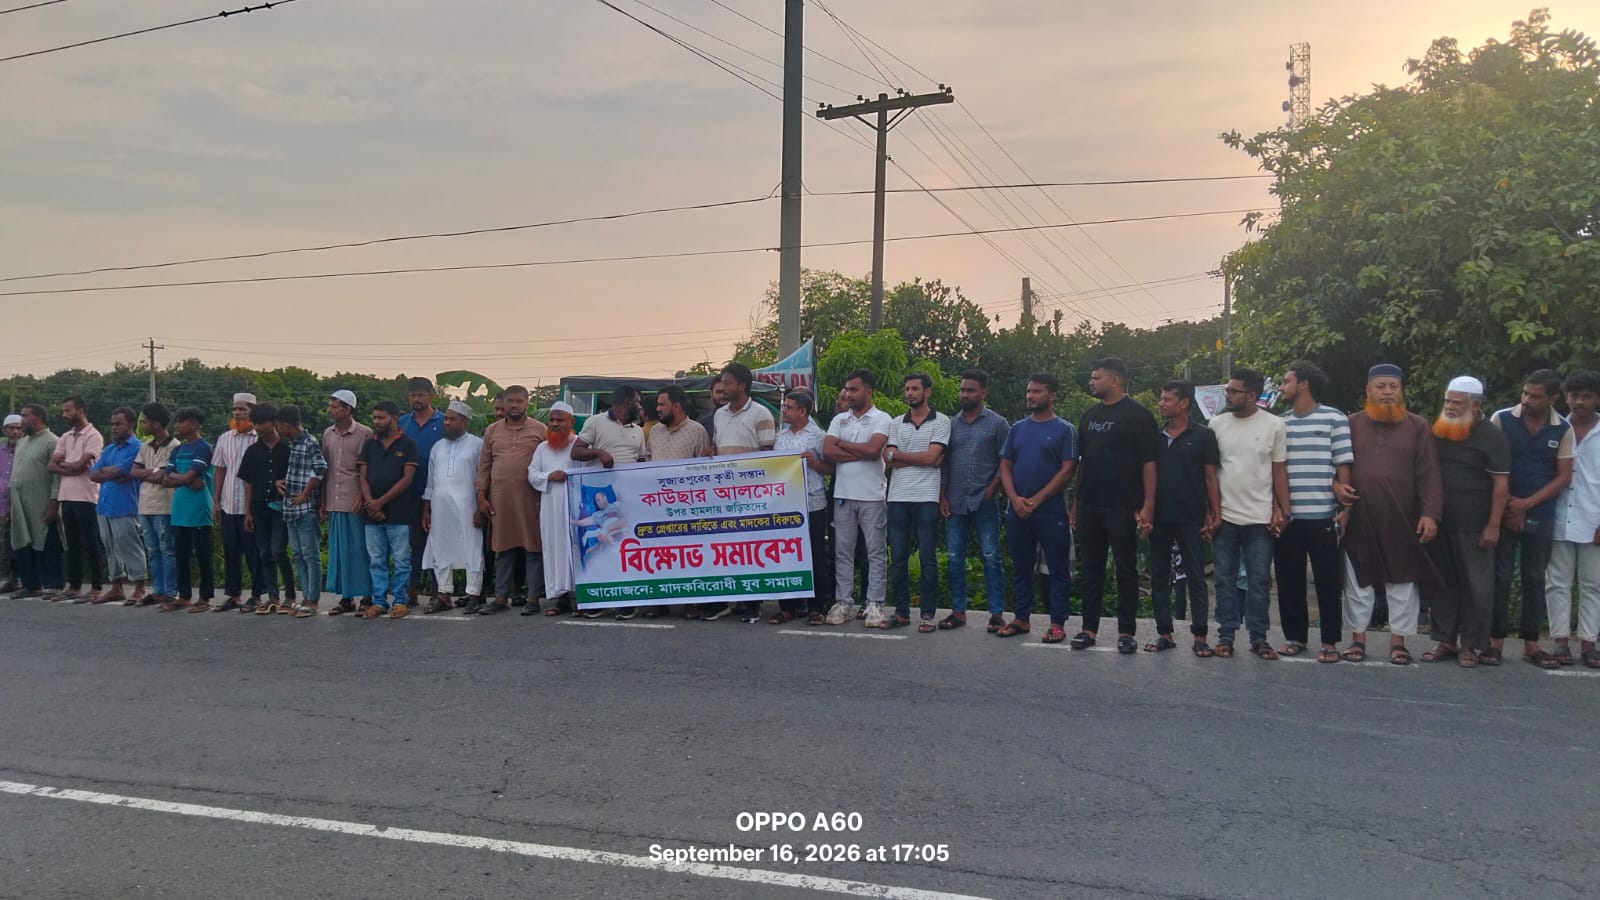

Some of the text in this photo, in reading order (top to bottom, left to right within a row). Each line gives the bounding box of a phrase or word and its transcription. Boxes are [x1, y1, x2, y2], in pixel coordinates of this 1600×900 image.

[737, 469, 765, 479] সন্তান
[639, 482, 786, 507] কাউছার আলমের
[665, 501, 767, 517] উপর হামলায় জড়িতদের
[690, 518, 718, 531] দাবিতে
[721, 519, 738, 530] এবং
[739, 516, 770, 528] মাদকের
[619, 537, 803, 574] বিক্ষোভ সমাবেশ
[587, 575, 804, 598] আয়োজনে: মাদকবিরোধী যুব সমাজ
